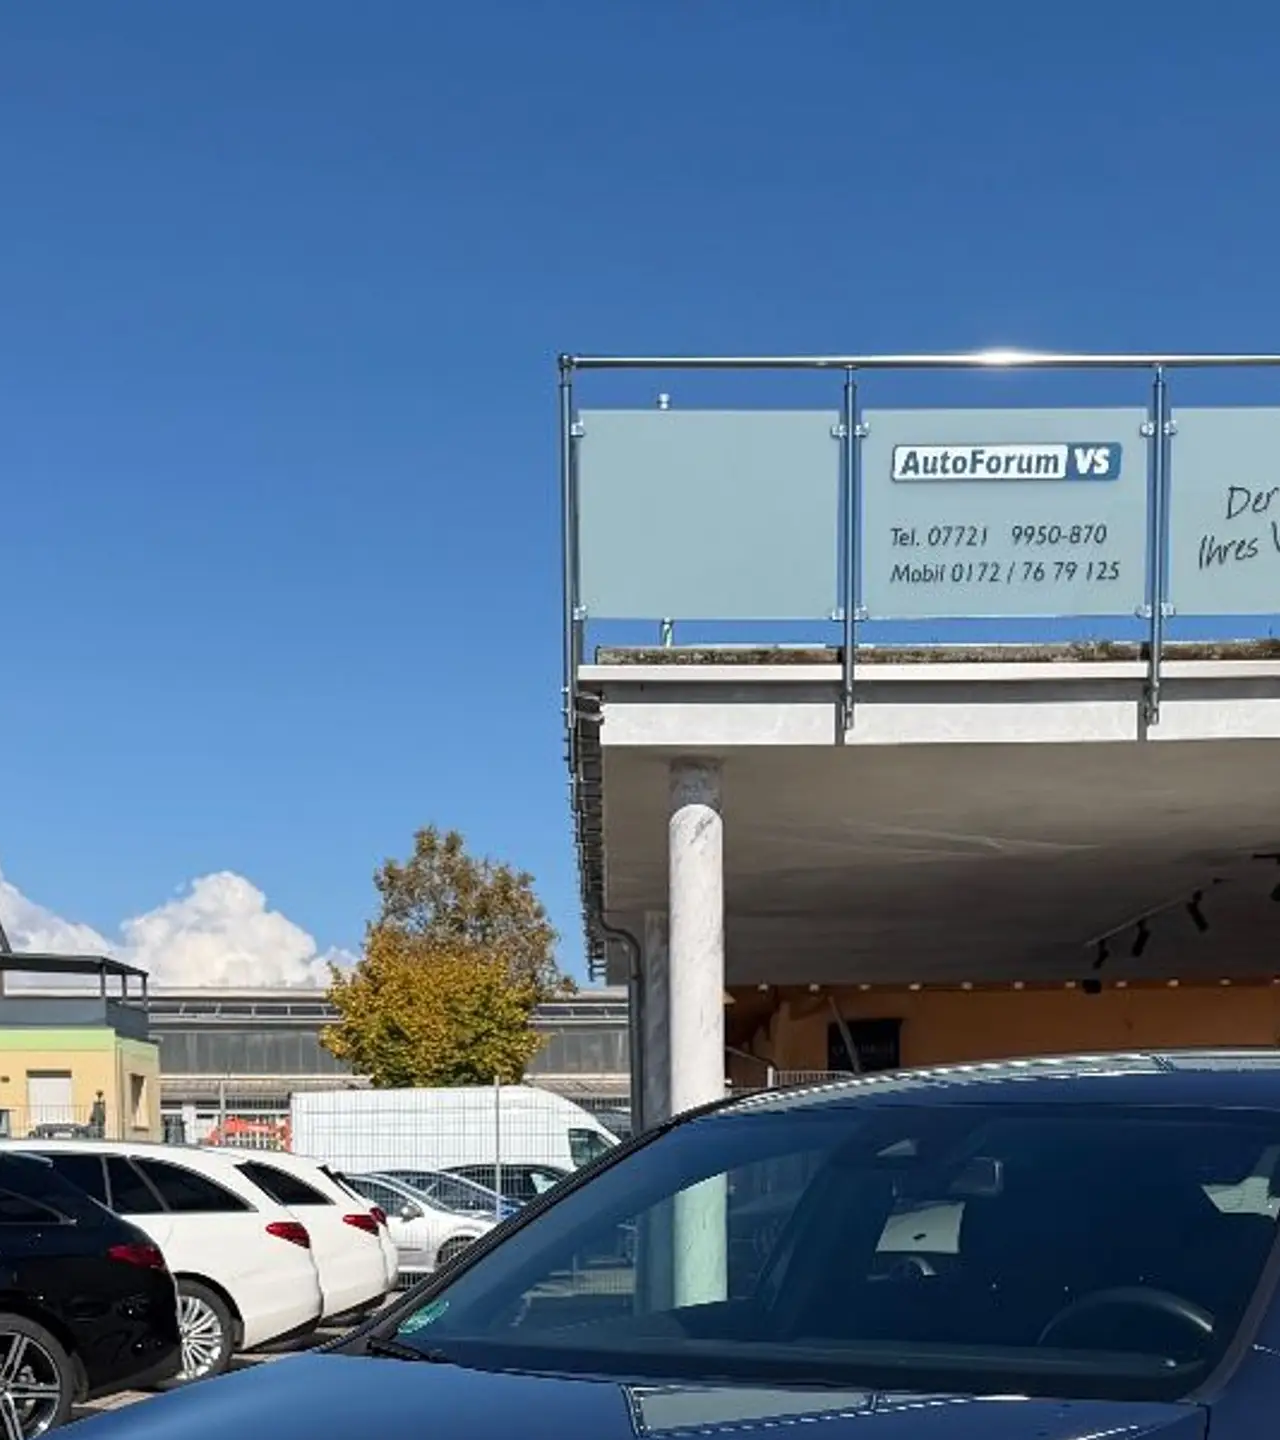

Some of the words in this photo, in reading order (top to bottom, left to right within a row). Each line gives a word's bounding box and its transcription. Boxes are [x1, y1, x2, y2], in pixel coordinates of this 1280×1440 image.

[901, 449, 1060, 476] AutoForum
[1075, 447, 1111, 475] VS
[1226, 485, 1280, 520] Der
[891, 527, 920, 547] Tel.
[928, 526, 988, 548] 07721
[1012, 525, 1107, 546] 9950-870
[1199, 534, 1259, 570] Ihres
[891, 562, 945, 583] Mobil
[951, 563, 1000, 583] 0172
[1023, 562, 1046, 581] 76
[1054, 561, 1077, 581] 79
[1086, 560, 1120, 581] 125
